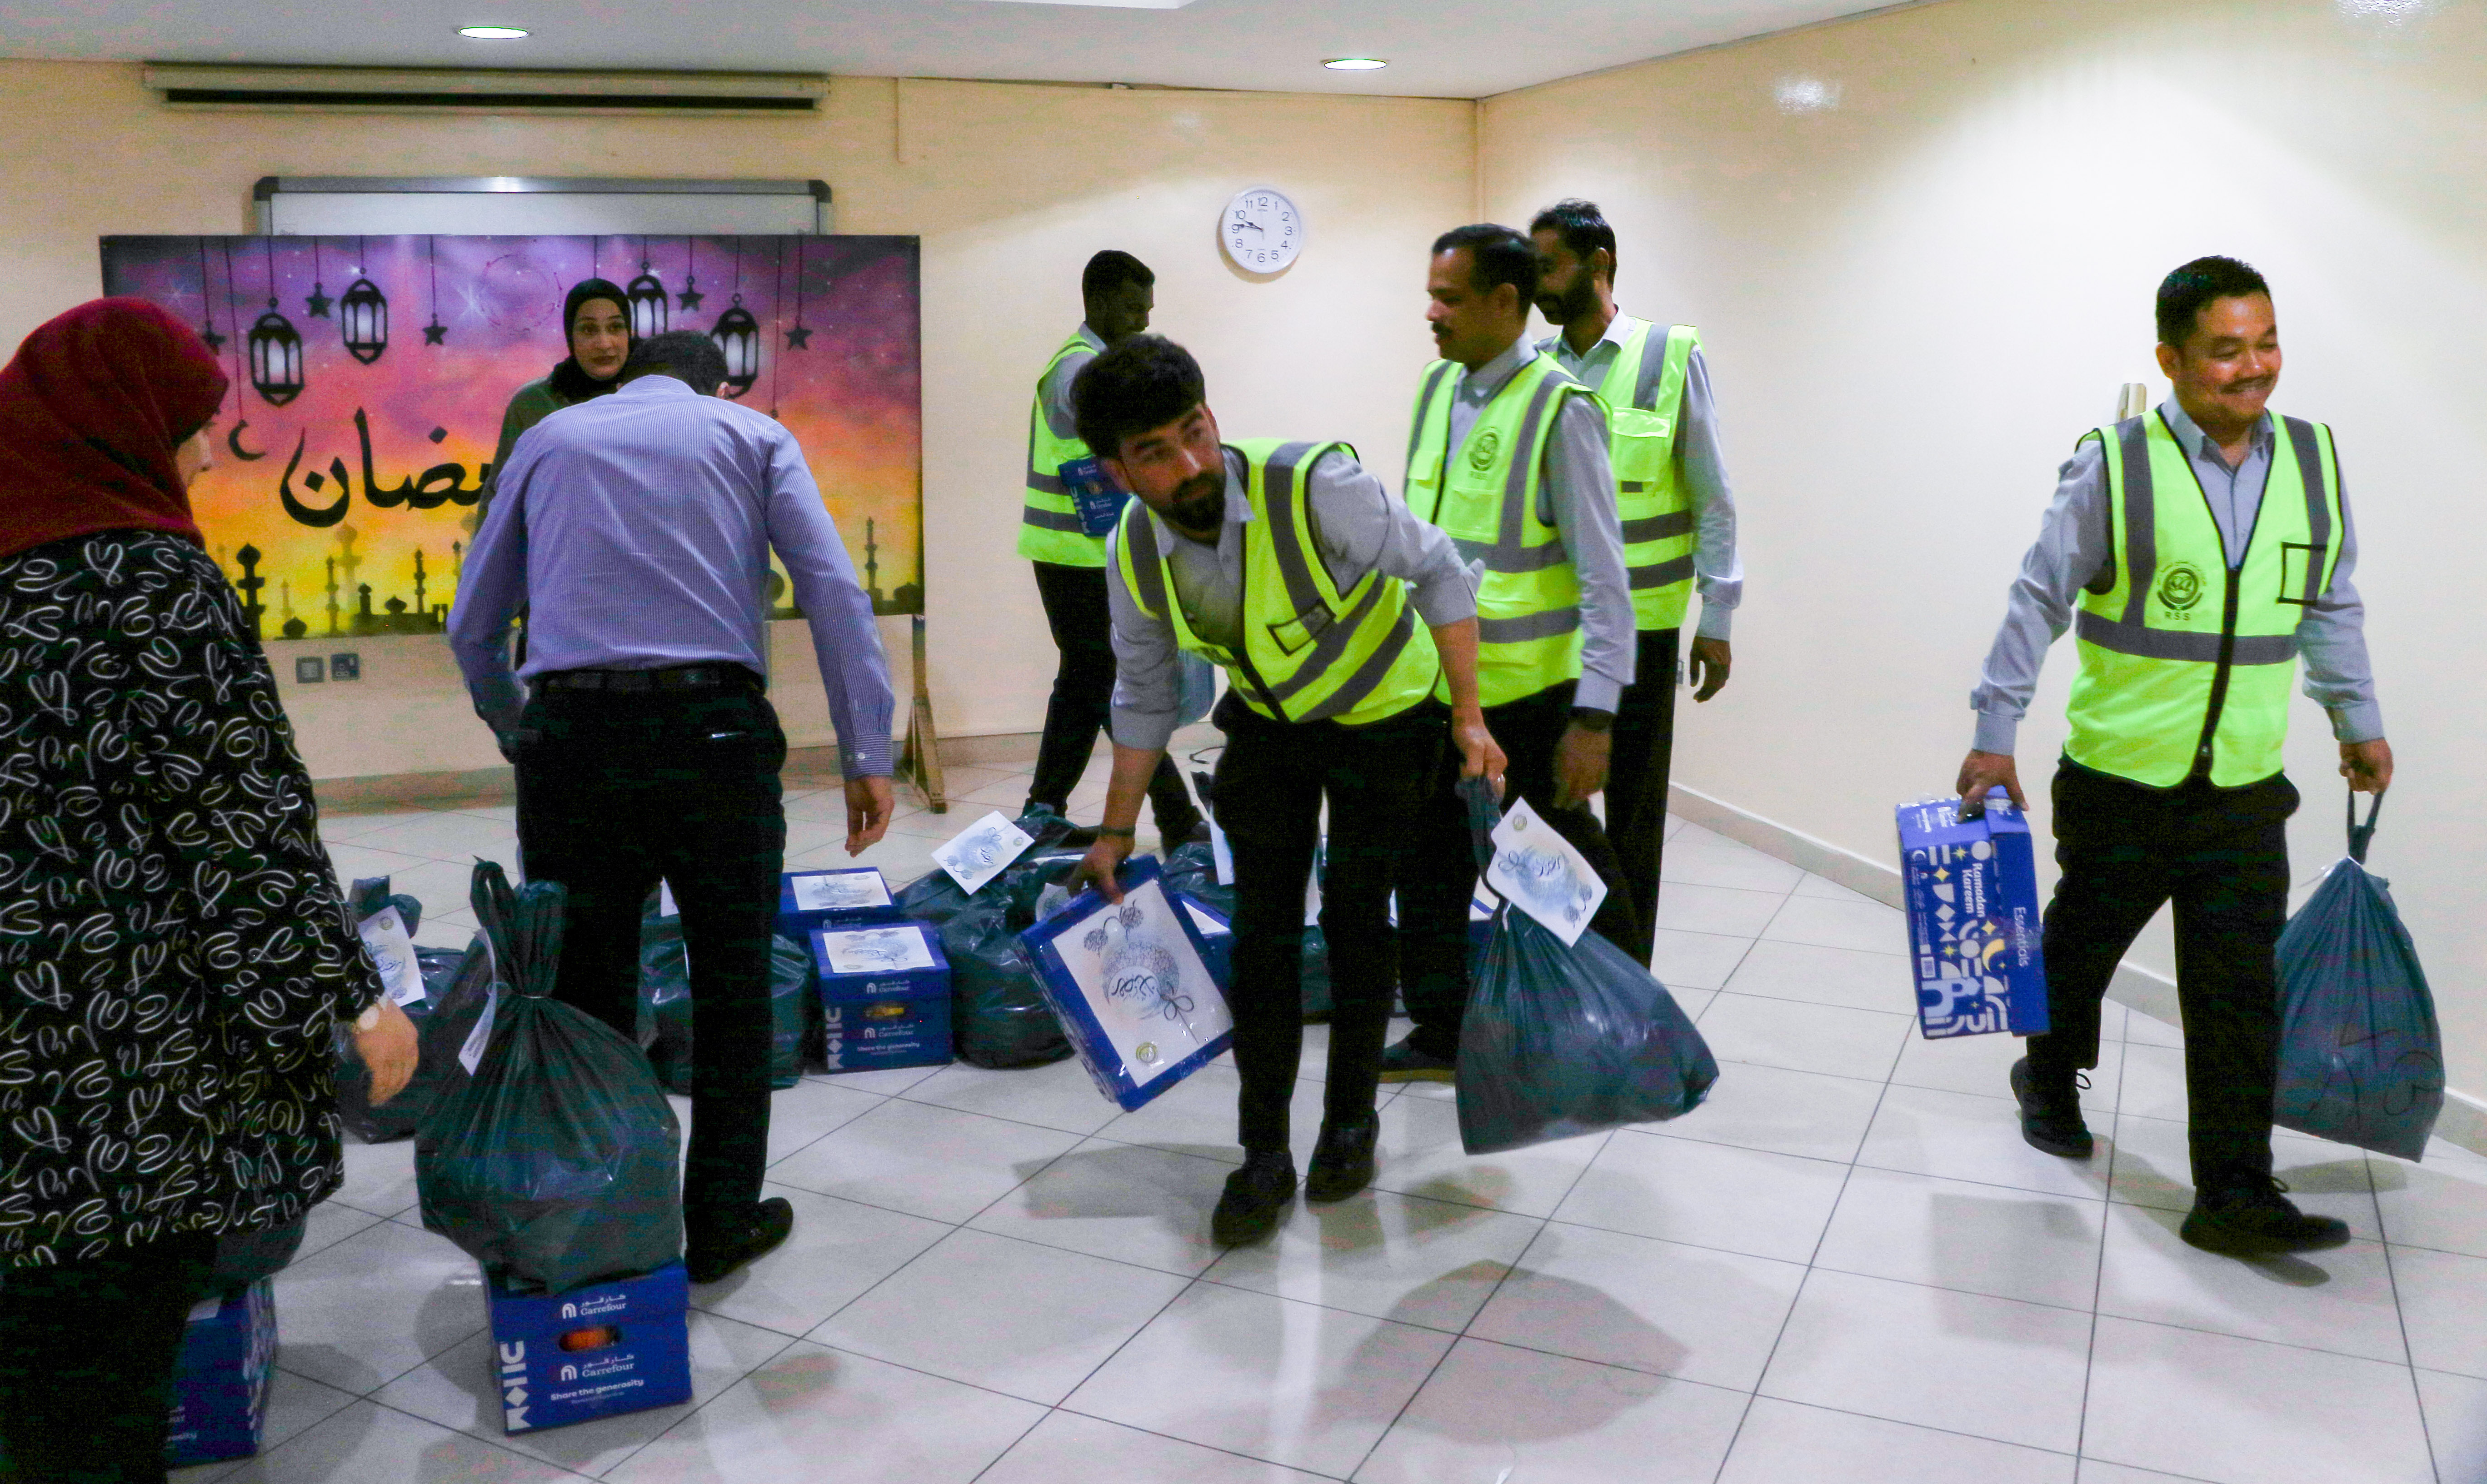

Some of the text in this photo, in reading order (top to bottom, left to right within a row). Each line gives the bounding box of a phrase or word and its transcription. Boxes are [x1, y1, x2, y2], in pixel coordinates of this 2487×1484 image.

[1245, 200, 1253, 209] 11
[1257, 197, 1268, 207] 12
[1235, 210, 1246, 219] 10
[1282, 211, 1289, 222] 2
[1231, 224, 1239, 234] 9
[1284, 226, 1293, 236] 3
[1235, 239, 1243, 248] 8
[1280, 240, 1288, 250] 4
[1246, 249, 1253, 259] 7
[1257, 253, 1266, 263] 6
[1271, 250, 1279, 260] 5
[1961, 868, 1974, 914] Kareem
[1972, 862, 1986, 918] Ramadan
[2013, 906, 2030, 968] Essentials
[580, 1303, 626, 1316] Carrefour
[582, 1363, 634, 1377] Carrefour
[550, 1391, 577, 1401] Share
[595, 1379, 644, 1394] generosity
